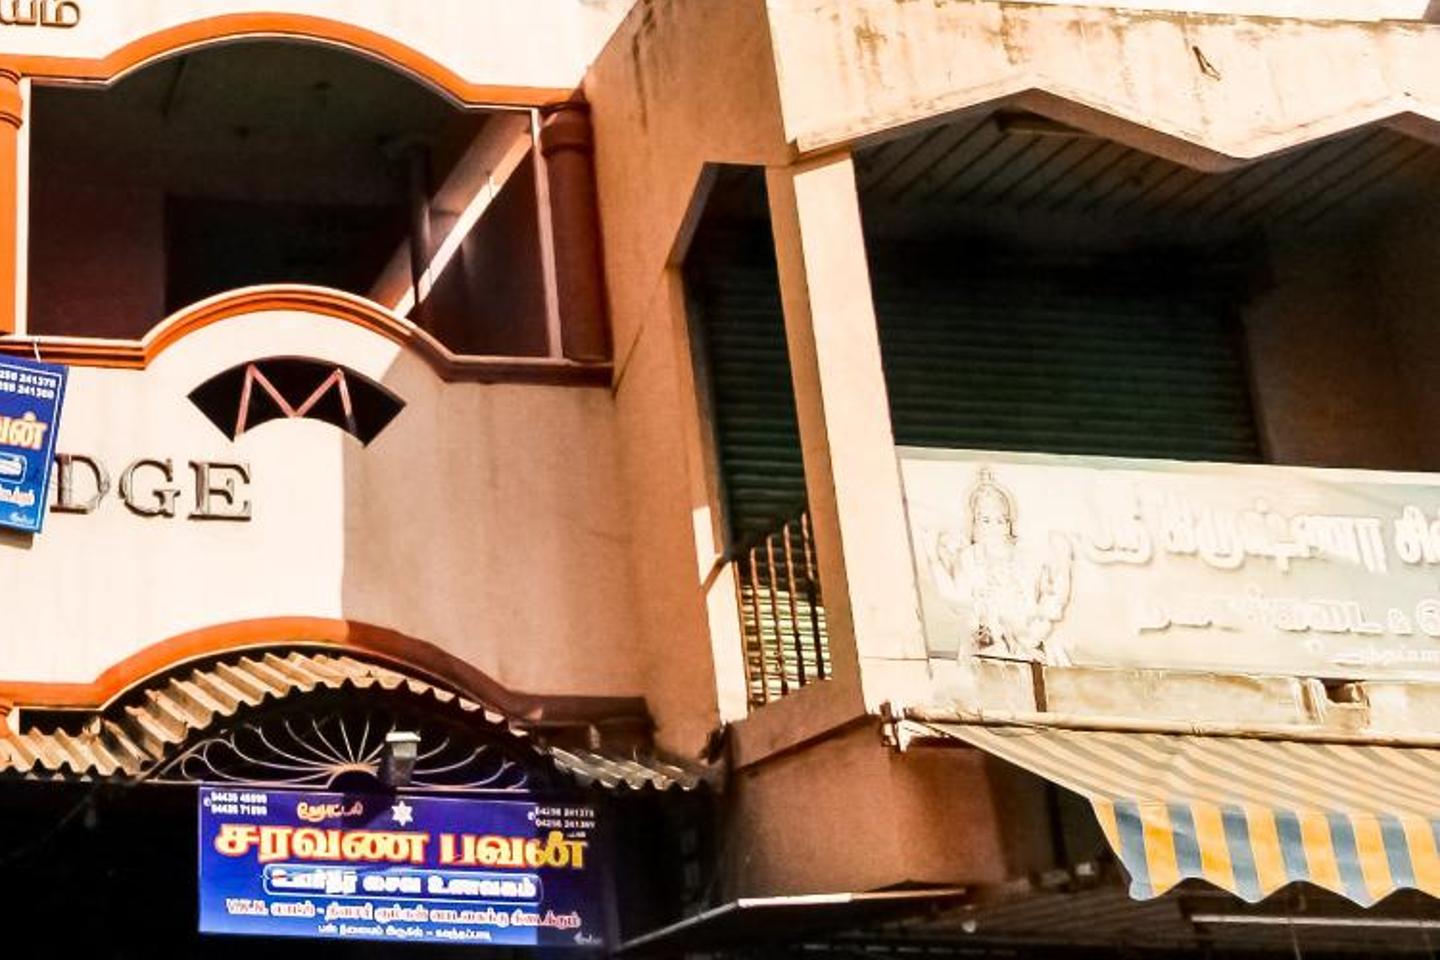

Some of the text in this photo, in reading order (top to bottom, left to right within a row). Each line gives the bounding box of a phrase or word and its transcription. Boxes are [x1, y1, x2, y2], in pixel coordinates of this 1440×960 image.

[50, 452, 253, 522] DGE
[214, 823, 589, 869] சரவண பவன்
